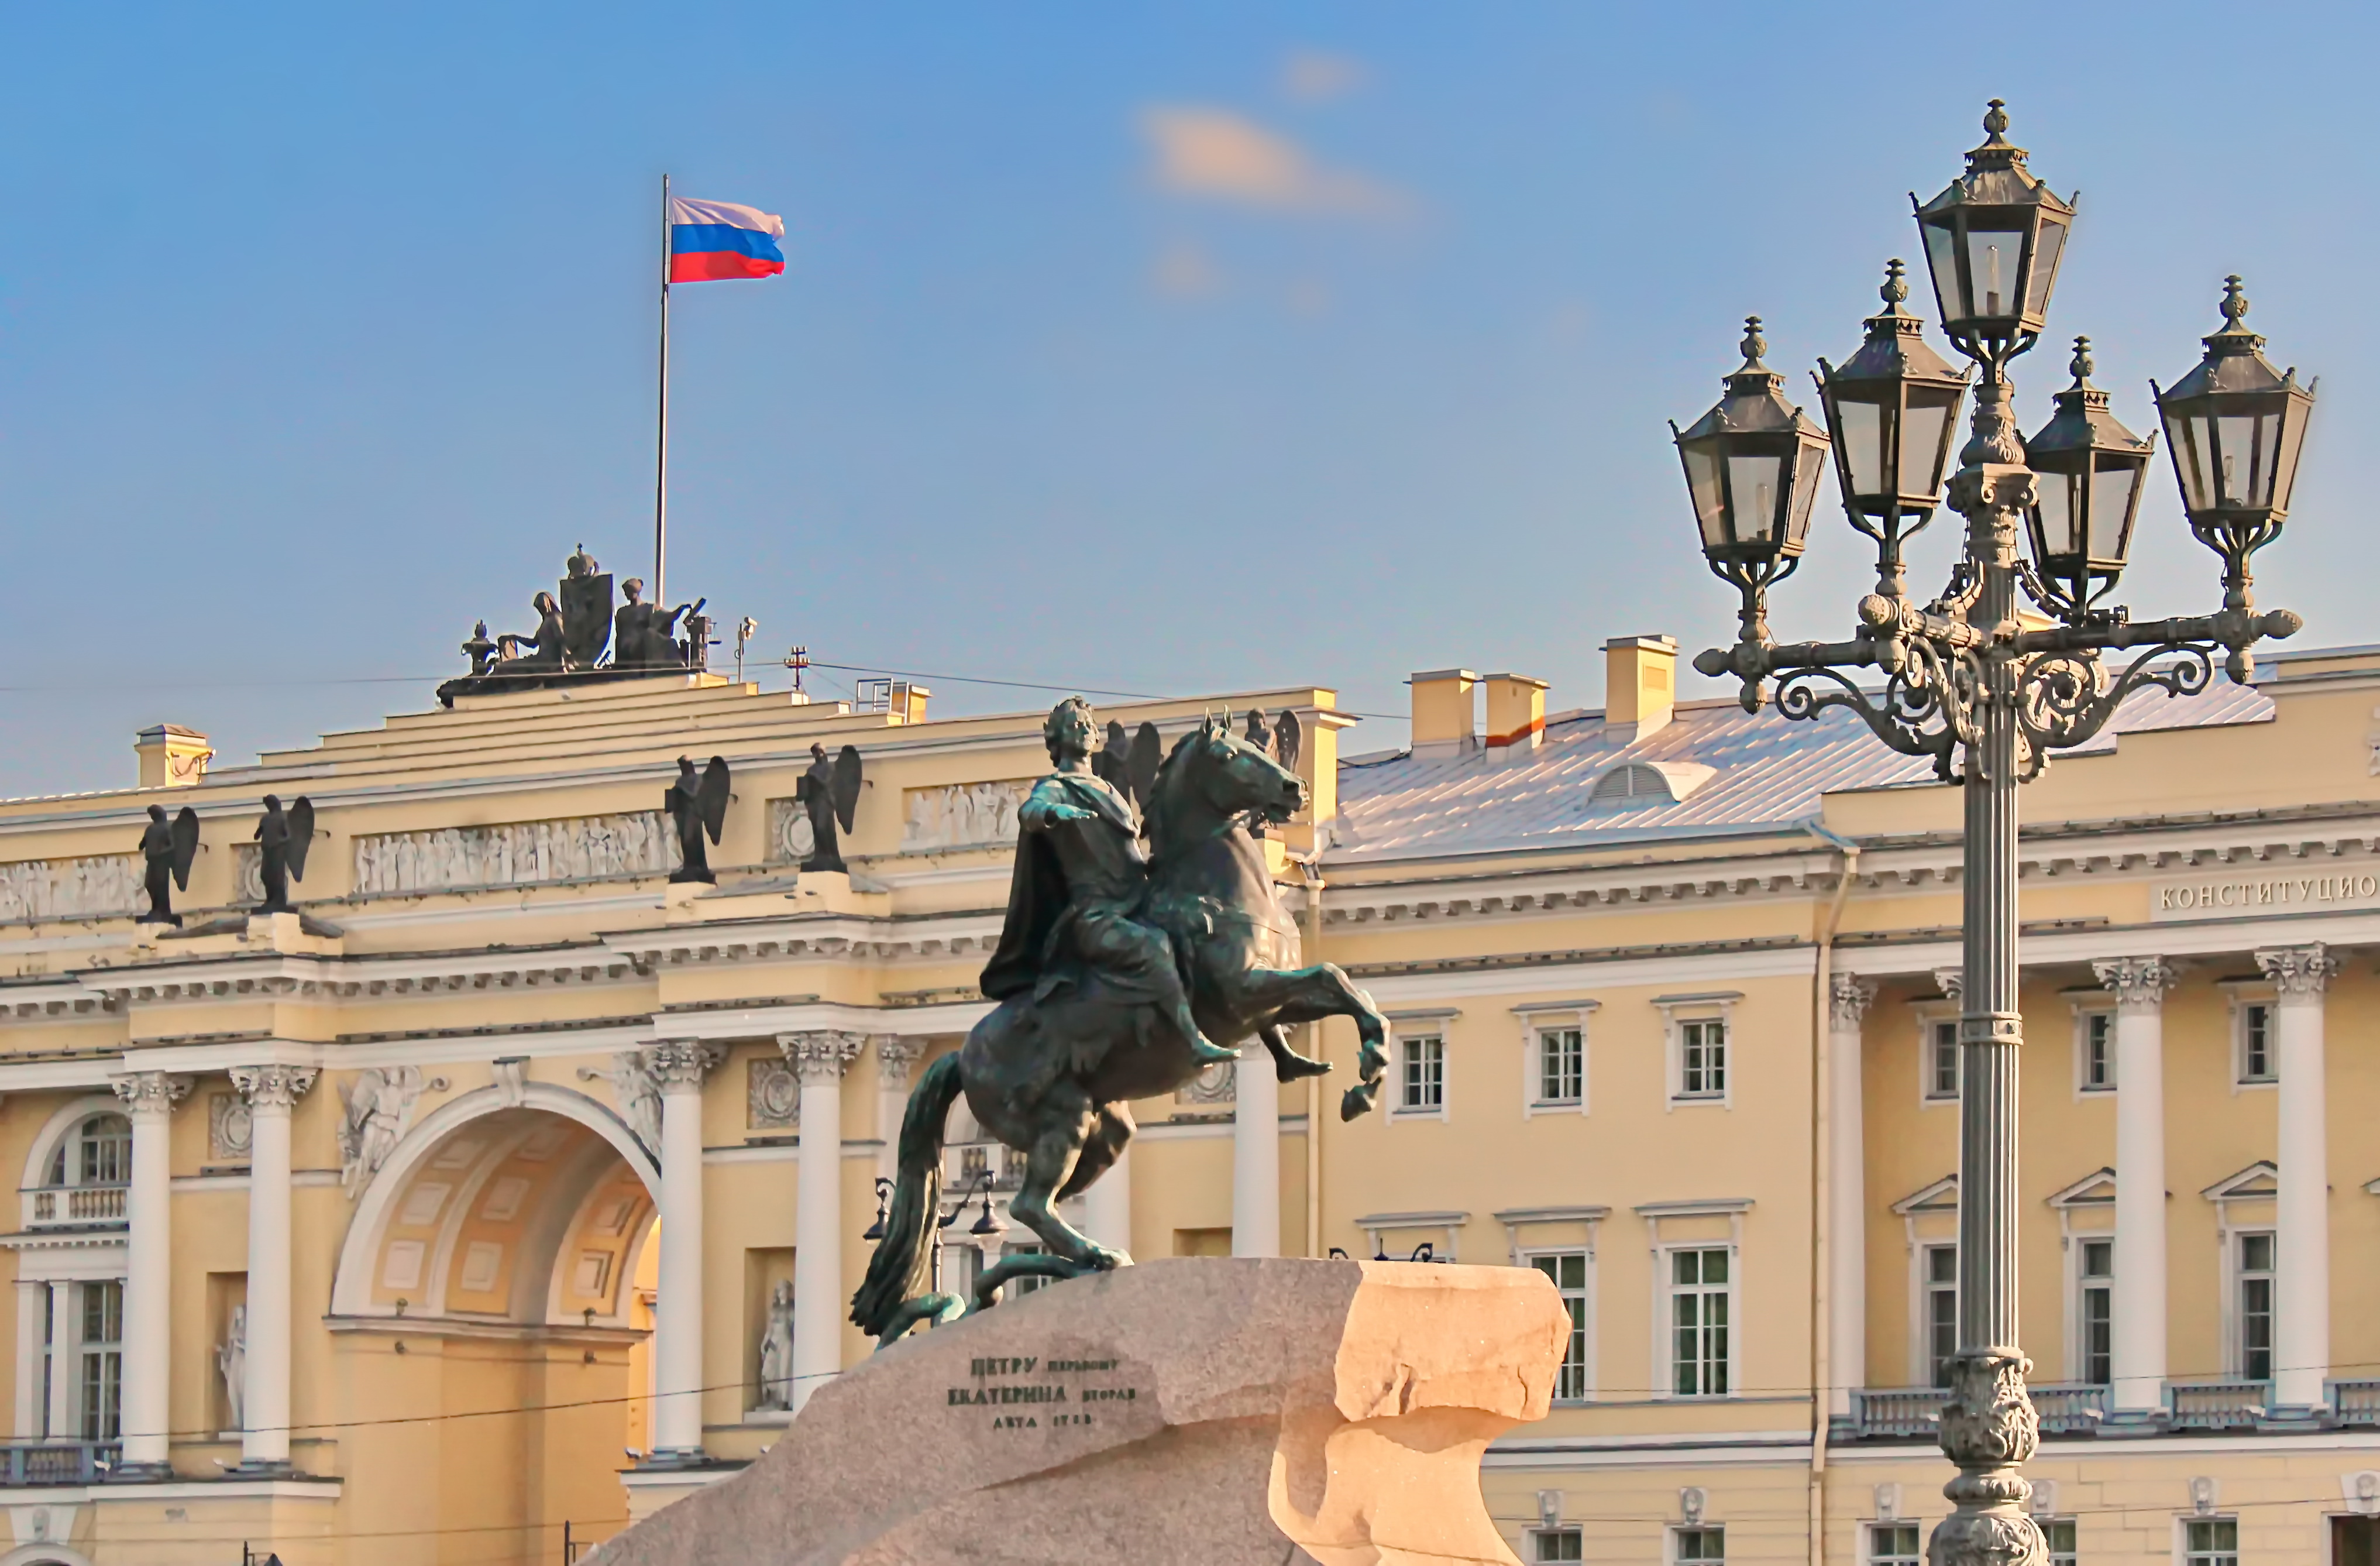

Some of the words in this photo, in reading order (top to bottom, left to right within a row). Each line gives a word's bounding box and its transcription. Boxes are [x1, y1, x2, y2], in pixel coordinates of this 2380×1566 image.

[2161, 876, 2376, 910] КОНСТИТУЦИО
[971, 1356, 1038, 1376] ПЕТРУ
[947, 1385, 1067, 1406] ЕКАТЕРИНА
